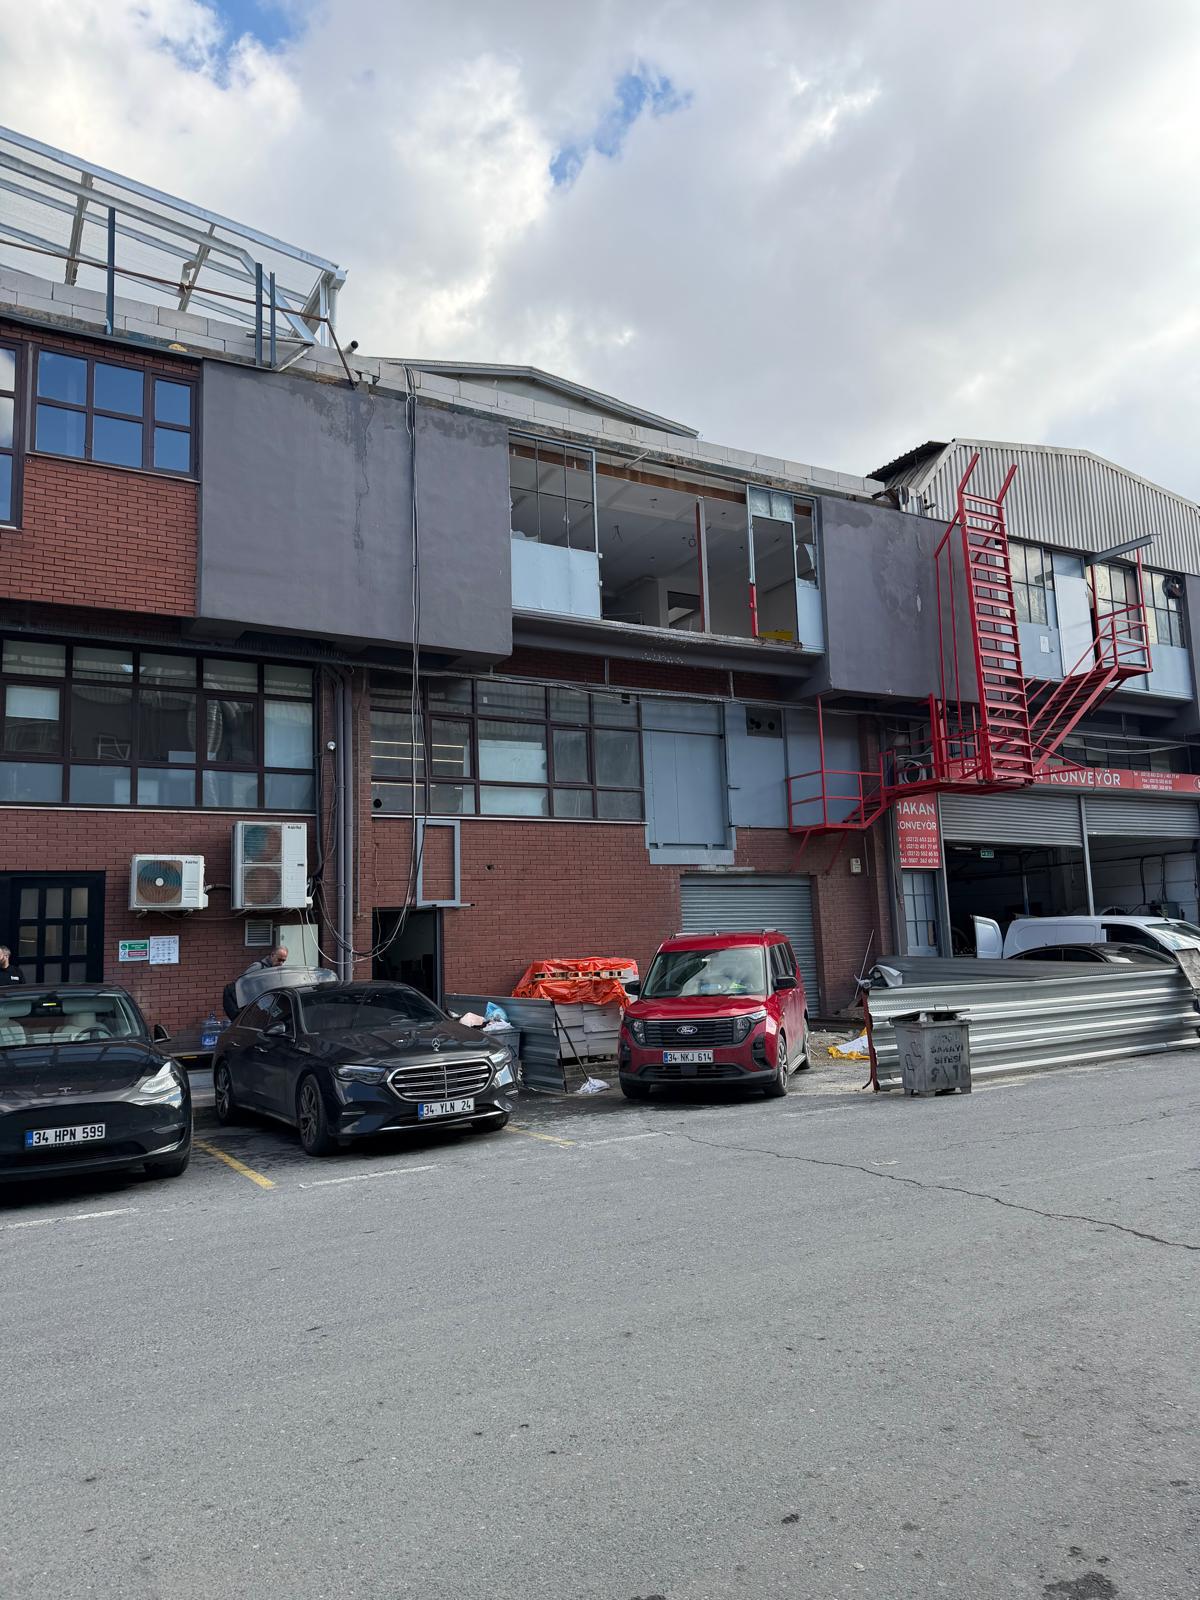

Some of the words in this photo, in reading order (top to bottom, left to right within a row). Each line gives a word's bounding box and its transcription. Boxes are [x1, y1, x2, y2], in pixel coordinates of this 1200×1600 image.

[1050, 769, 1121, 786] KONVEYÖR
[668, 1053, 677, 1062] 34
[680, 1053, 695, 1061] NKJ
[698, 1053, 712, 1062] 614
[424, 1105, 434, 1116] 34
[440, 1102, 455, 1113] YLN
[462, 1100, 471, 1111] 24
[34, 1132, 48, 1144] 34
[54, 1128, 76, 1142] HPN
[82, 1126, 103, 1139] 599
